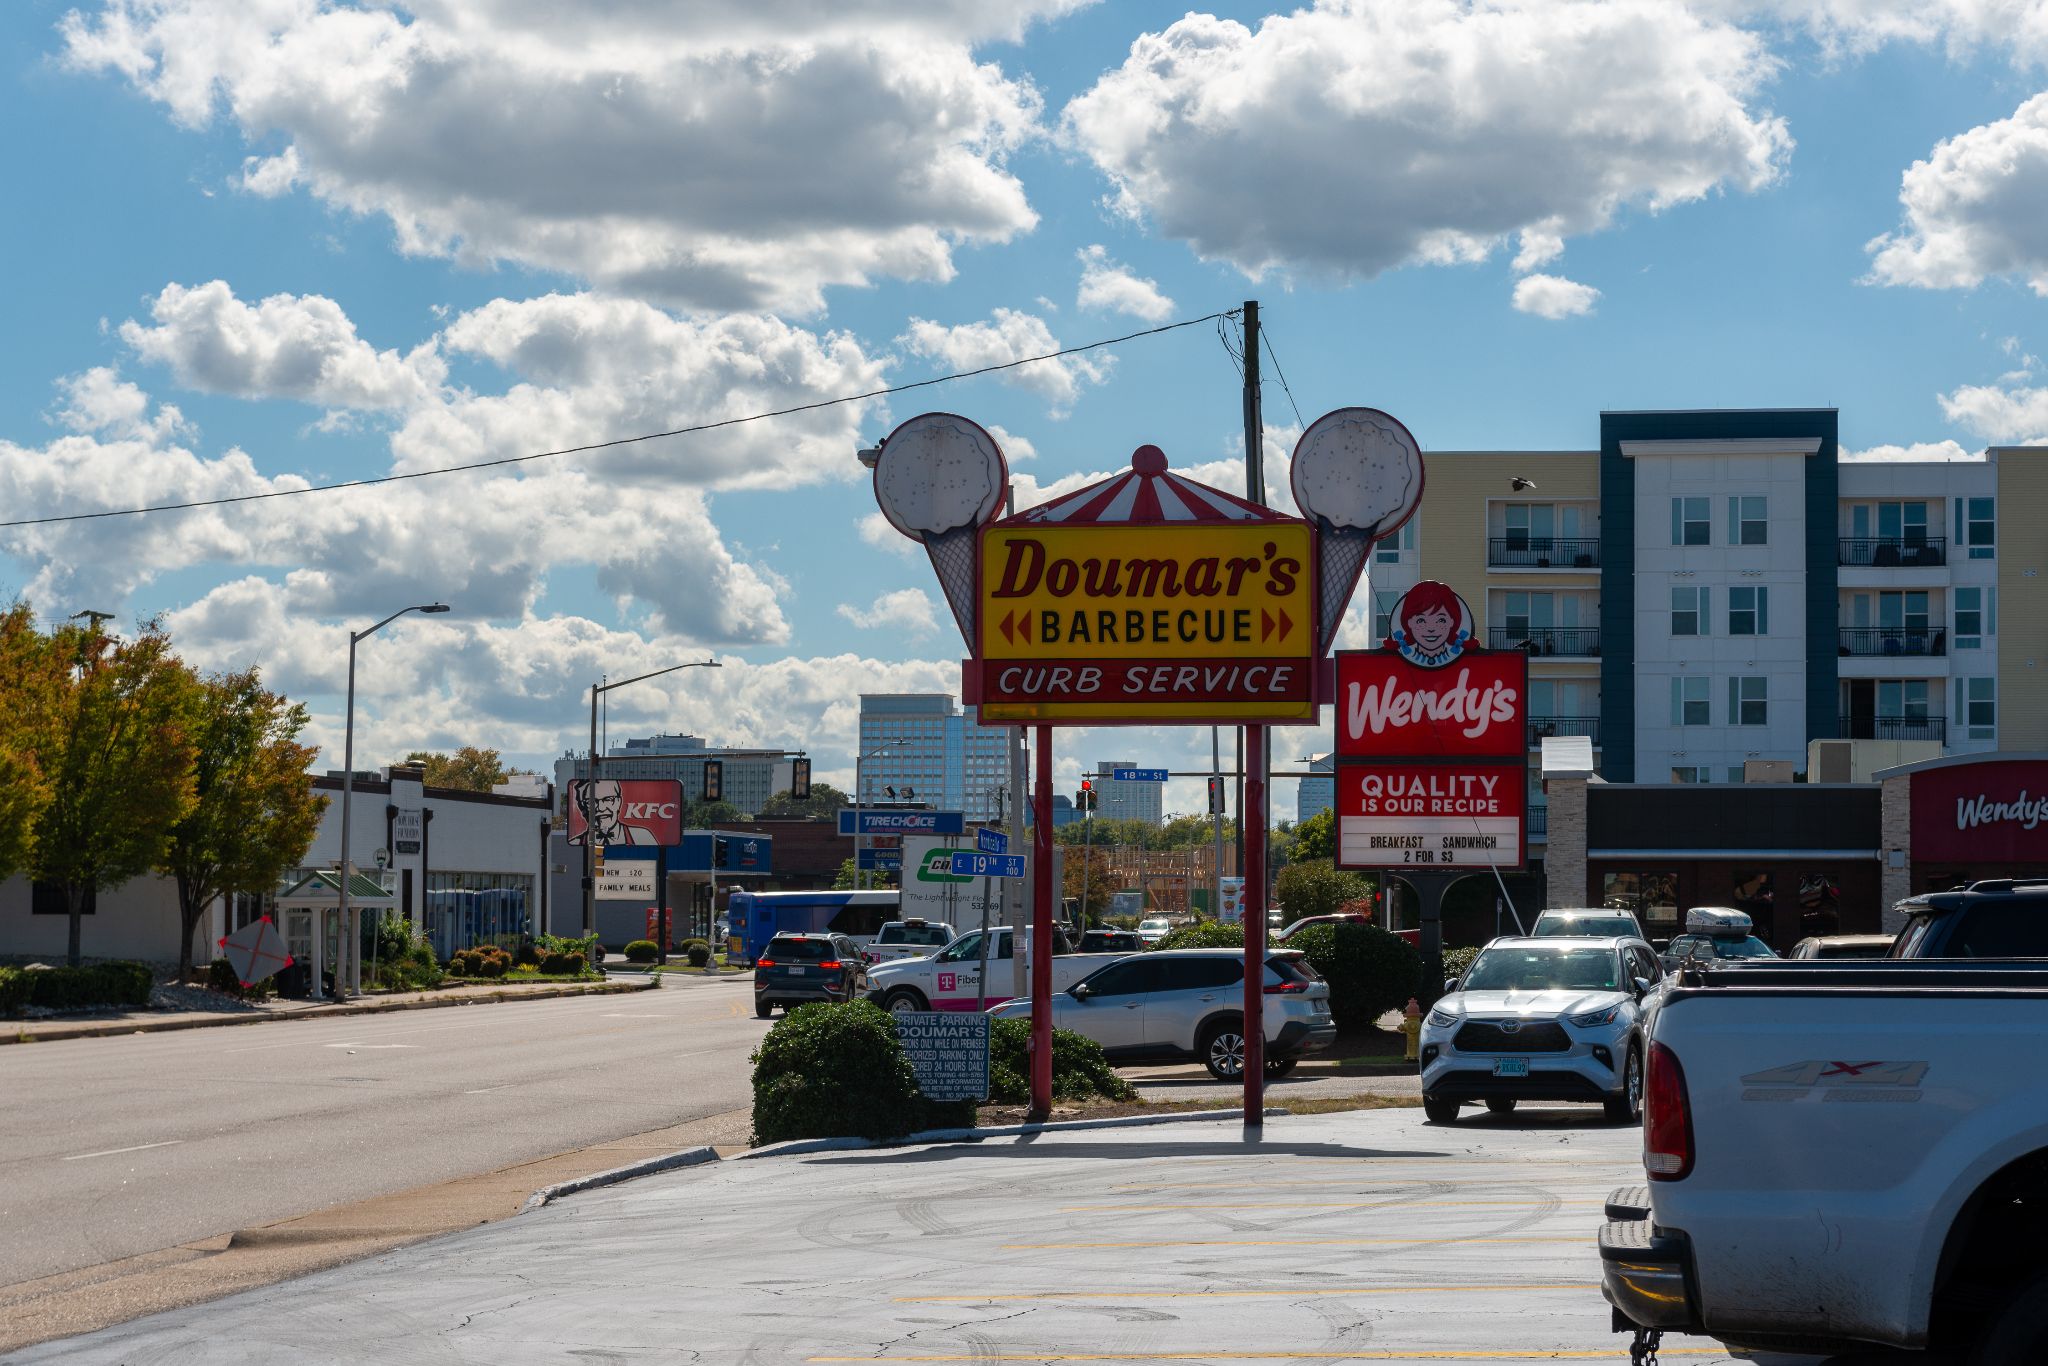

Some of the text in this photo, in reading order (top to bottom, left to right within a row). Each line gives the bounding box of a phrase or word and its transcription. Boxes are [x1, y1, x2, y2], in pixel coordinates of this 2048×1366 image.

[991, 538, 1301, 598] Doumar's
[1041, 608, 1251, 643] BARBECUE
[999, 665, 1295, 694] CURB SERVICE
[1347, 667, 1517, 740] Wendy's
[1361, 774, 1499, 798] QUALITY
[624, 802, 676, 819] KFC
[1361, 798, 1498, 813] IS OUR RECIPE
[1370, 836, 1497, 849] BREAKFAST SANDWHICH
[1404, 850, 1410, 863] 2
[1415, 850, 1434, 863] FOR
[957, 859, 963, 868] E
[1008, 858, 1017, 867] ST
[606, 869, 620, 877] NEW
[1006, 866, 1019, 876] 100
[599, 884, 651, 892] FAMILY MEALS
[957, 975, 980, 985] Fiber
[898, 1015, 986, 1026] PRIVATE PARKING
[898, 1026, 986, 1037] DOUMAR'S
[920, 1039, 934, 1049] ONLY
[934, 1039, 950, 1049] WHILE
[951, 1039, 959, 1049] ON
[961, 1039, 986, 1049] PREMISES
[939, 1050, 968, 1060] PARKING
[968, 1050, 985, 1060] ONLY
[934, 1061, 942, 1071] 24
[944, 1061, 966, 1071] HOURS
[968, 1061, 985, 1071] DAILY
